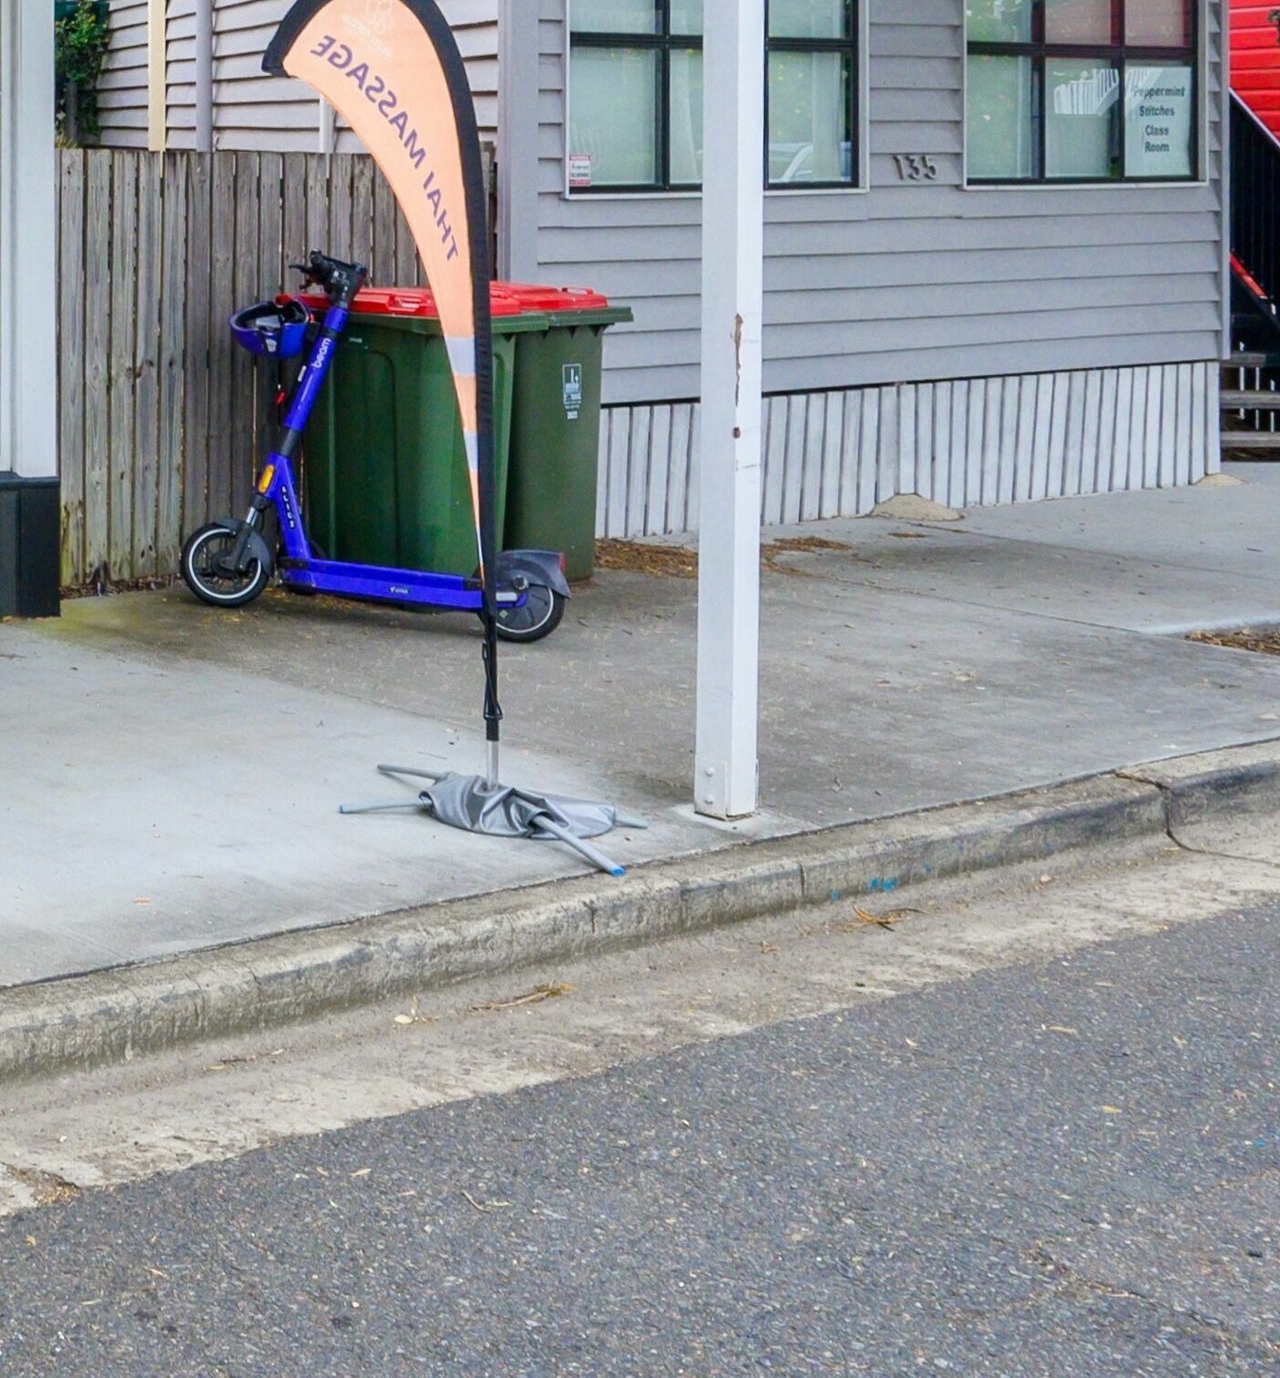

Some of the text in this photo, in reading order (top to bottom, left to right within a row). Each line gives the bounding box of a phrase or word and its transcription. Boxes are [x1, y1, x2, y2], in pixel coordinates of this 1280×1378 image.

[1139, 105, 1175, 117] Stitches
[1145, 125, 1169, 136] Class
[1145, 141, 1170, 153] Room
[892, 153, 937, 181] 135
[311, 337, 332, 369] beam
